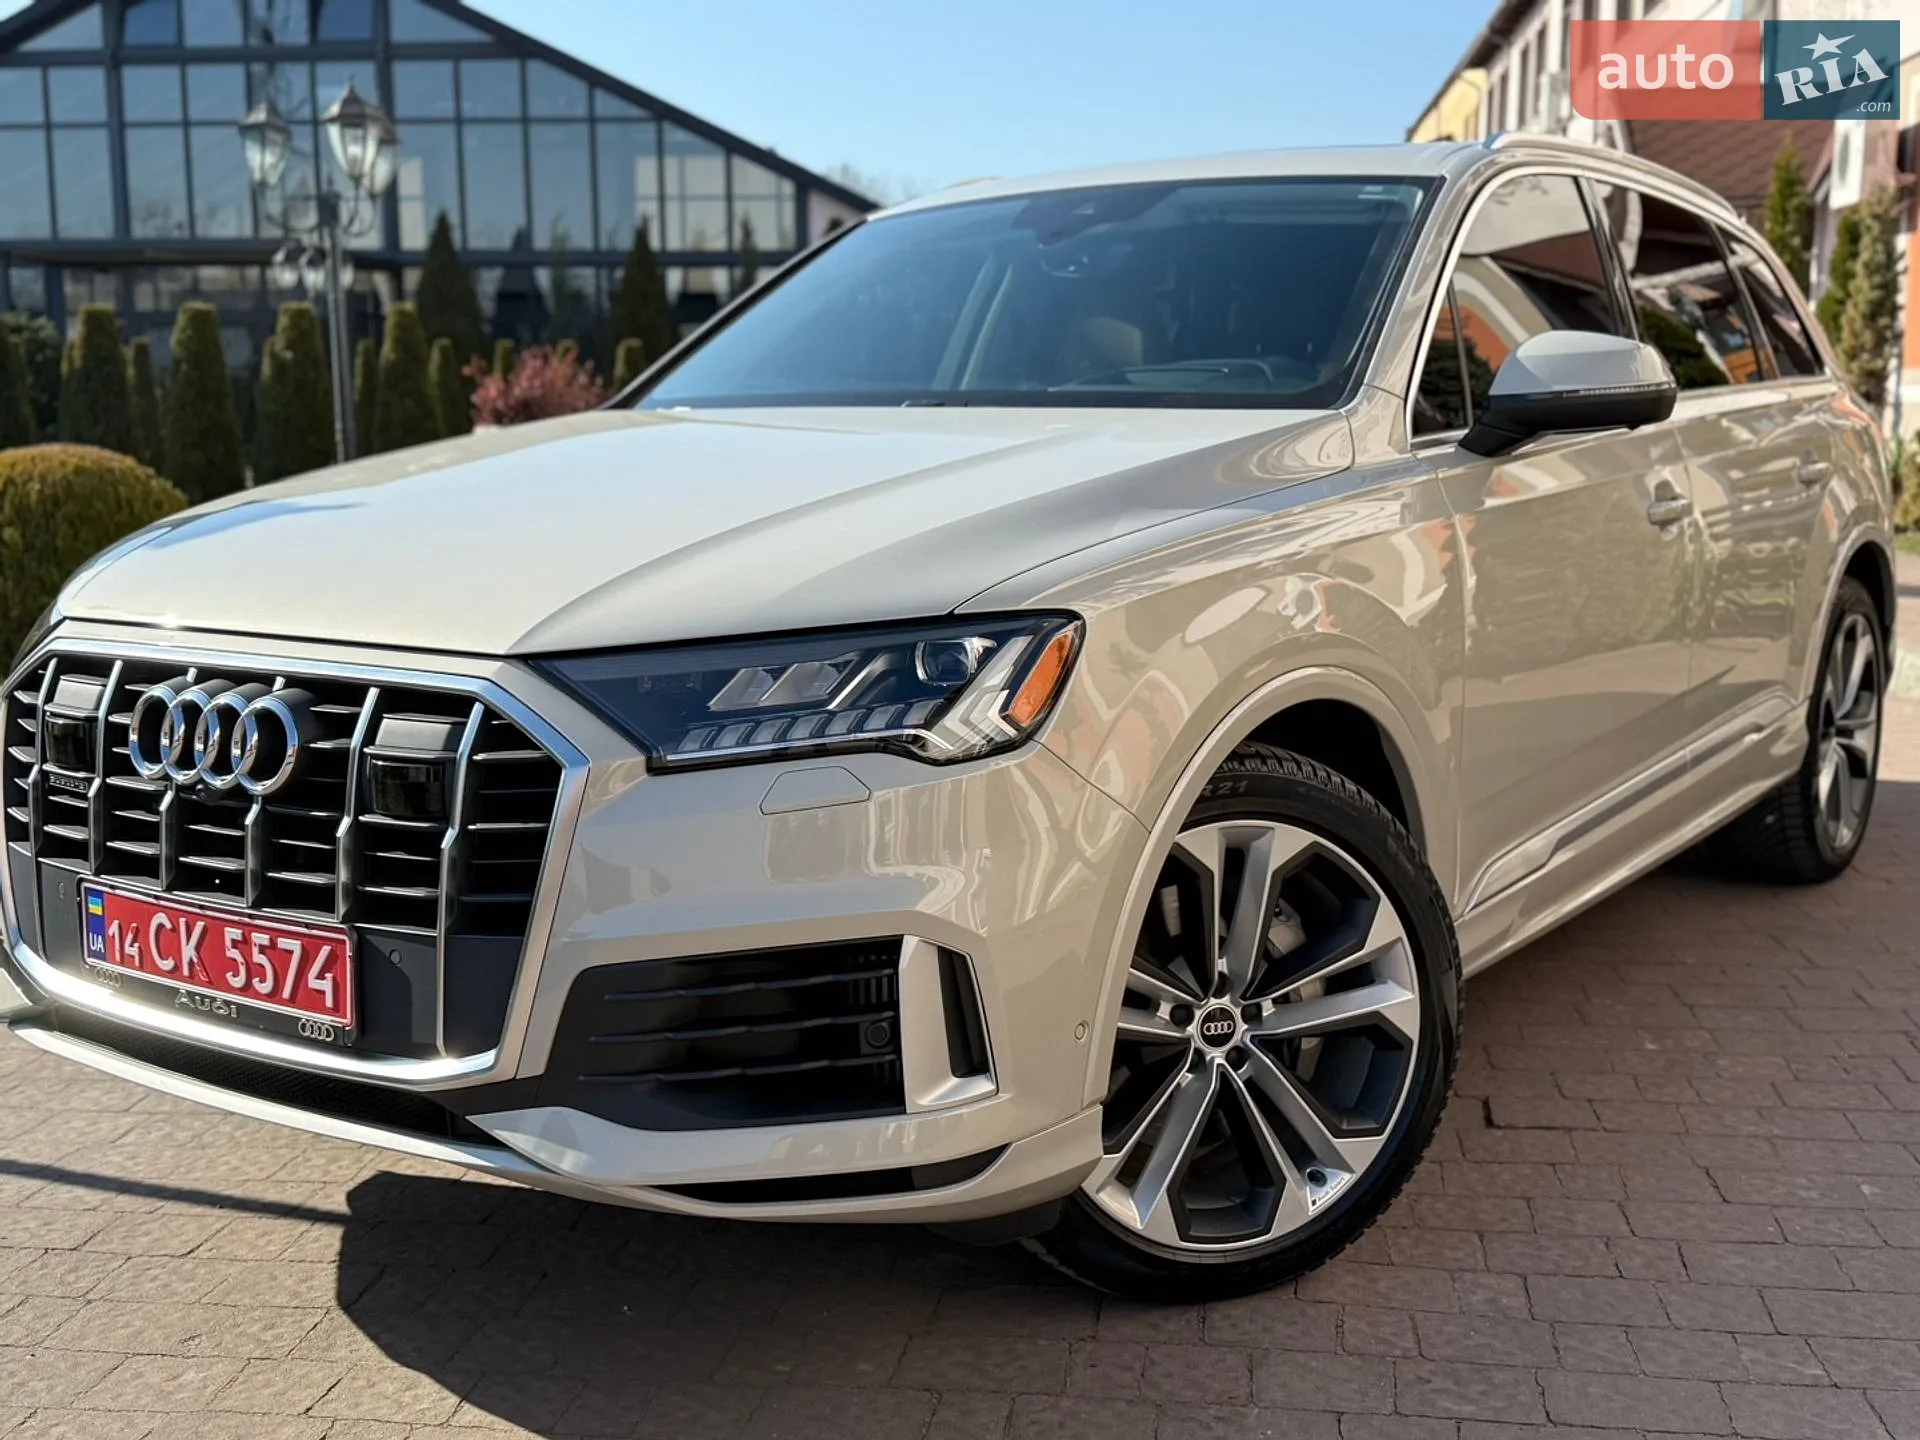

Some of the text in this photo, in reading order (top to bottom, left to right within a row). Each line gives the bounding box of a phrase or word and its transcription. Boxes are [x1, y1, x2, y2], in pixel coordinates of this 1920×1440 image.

[88, 935, 105, 953] UA
[108, 912, 333, 1008] 14 CK 5574
